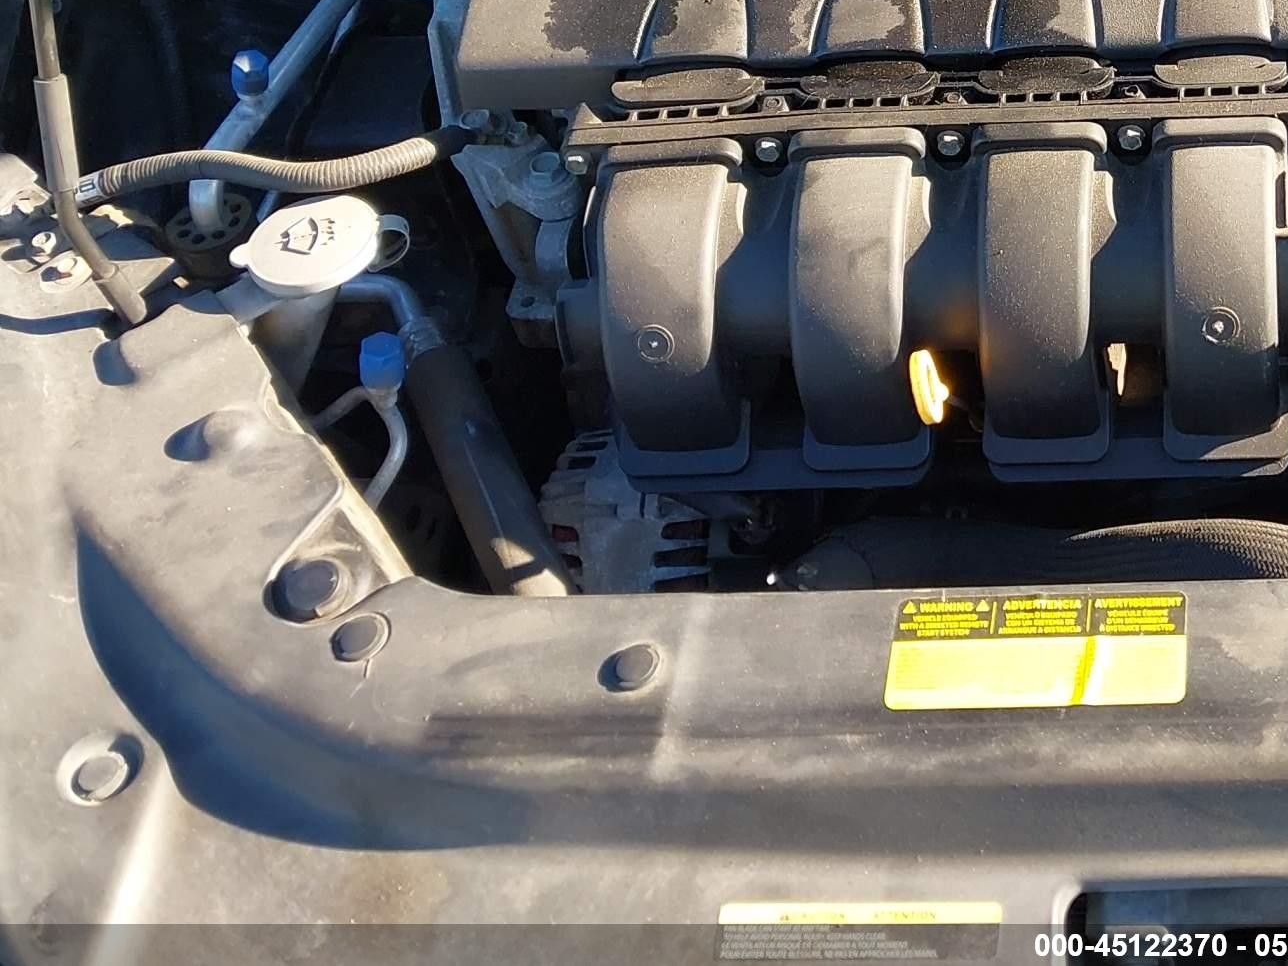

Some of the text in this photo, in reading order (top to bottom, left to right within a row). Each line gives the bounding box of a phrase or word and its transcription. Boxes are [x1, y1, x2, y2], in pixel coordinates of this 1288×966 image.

[919, 601, 974, 613] WARNING
[1003, 599, 1082, 611] ADVERTENCIA
[1094, 597, 1183, 609] AVERTISSEMENT
